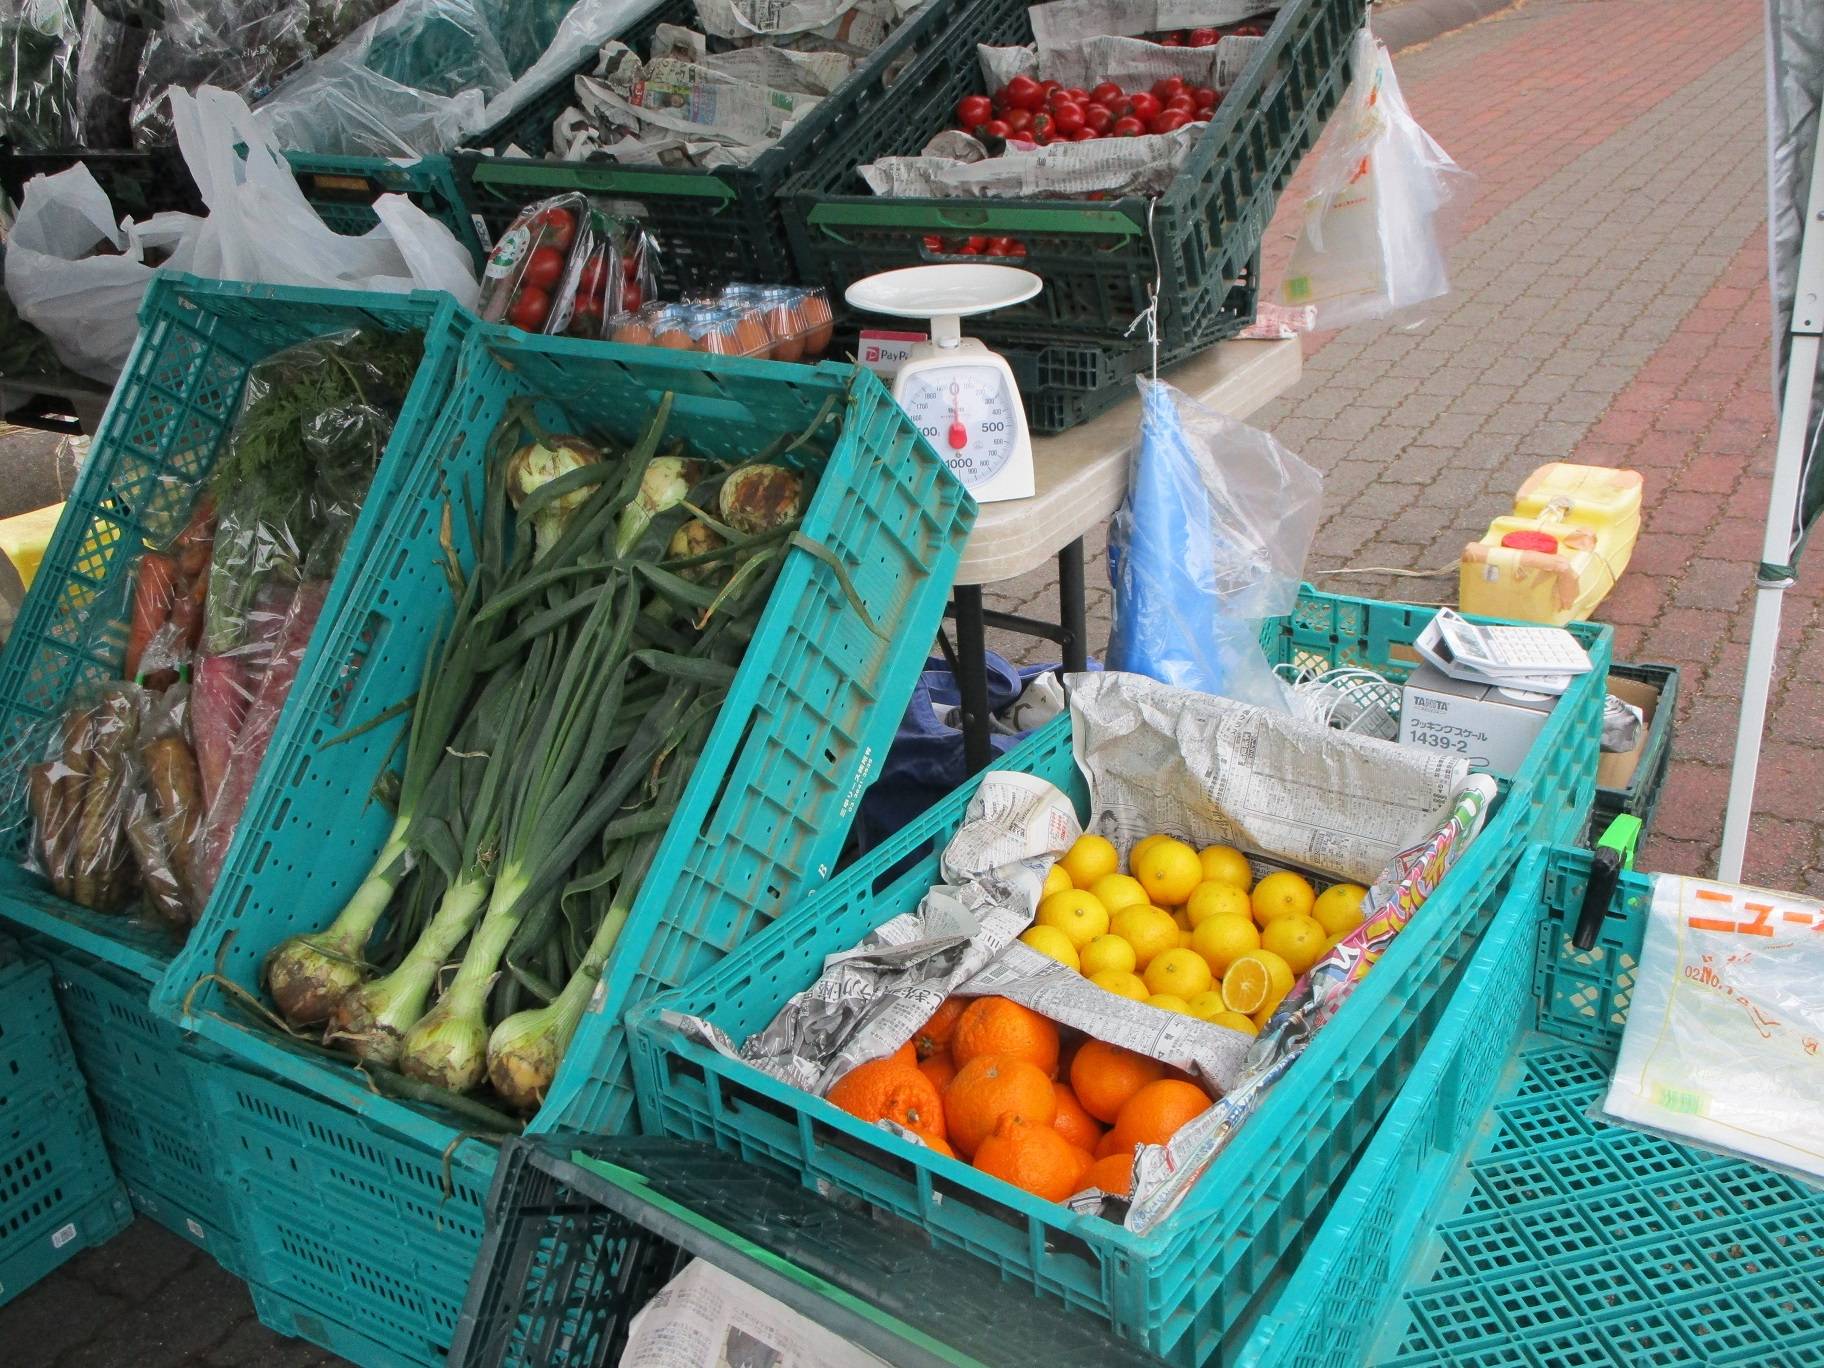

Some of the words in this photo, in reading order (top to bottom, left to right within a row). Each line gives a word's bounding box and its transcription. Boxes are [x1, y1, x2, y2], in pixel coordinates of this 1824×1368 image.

[948, 383, 960, 396] 0
[981, 422, 1004, 433] 500
[945, 458, 973, 469] 1000
[1411, 718, 1488, 742] クッキングスケール
[1410, 730, 1468, 753] 1439-2
[1688, 889, 1824, 937] ニュー
